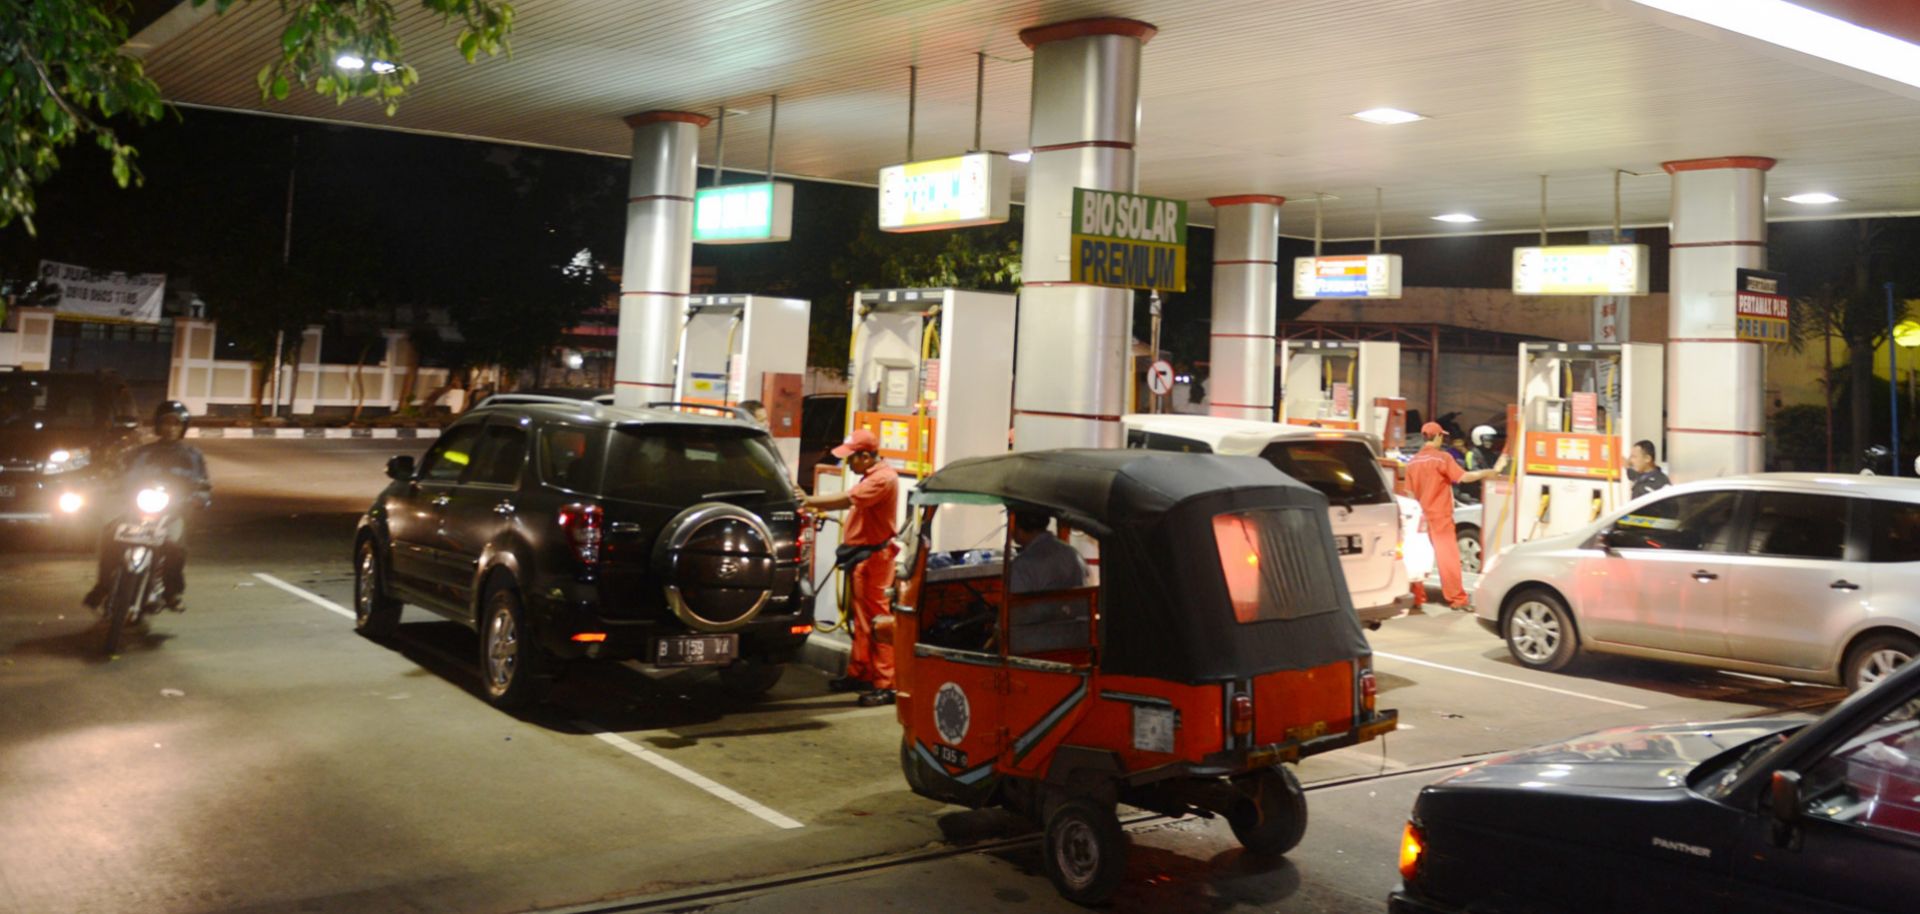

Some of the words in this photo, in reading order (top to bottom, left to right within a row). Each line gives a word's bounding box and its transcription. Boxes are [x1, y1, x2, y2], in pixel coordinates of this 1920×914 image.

[1082, 191, 1114, 236] BIO
[1116, 194, 1178, 243] SOLAR
[1081, 239, 1176, 290] PREMIUM
[1738, 294, 1771, 315] PERTAMAX
[1773, 298, 1788, 318] PLUS
[1738, 318, 1787, 340] PREMIUM
[659, 641, 668, 657] B
[1652, 837, 1712, 858] PANTHER
